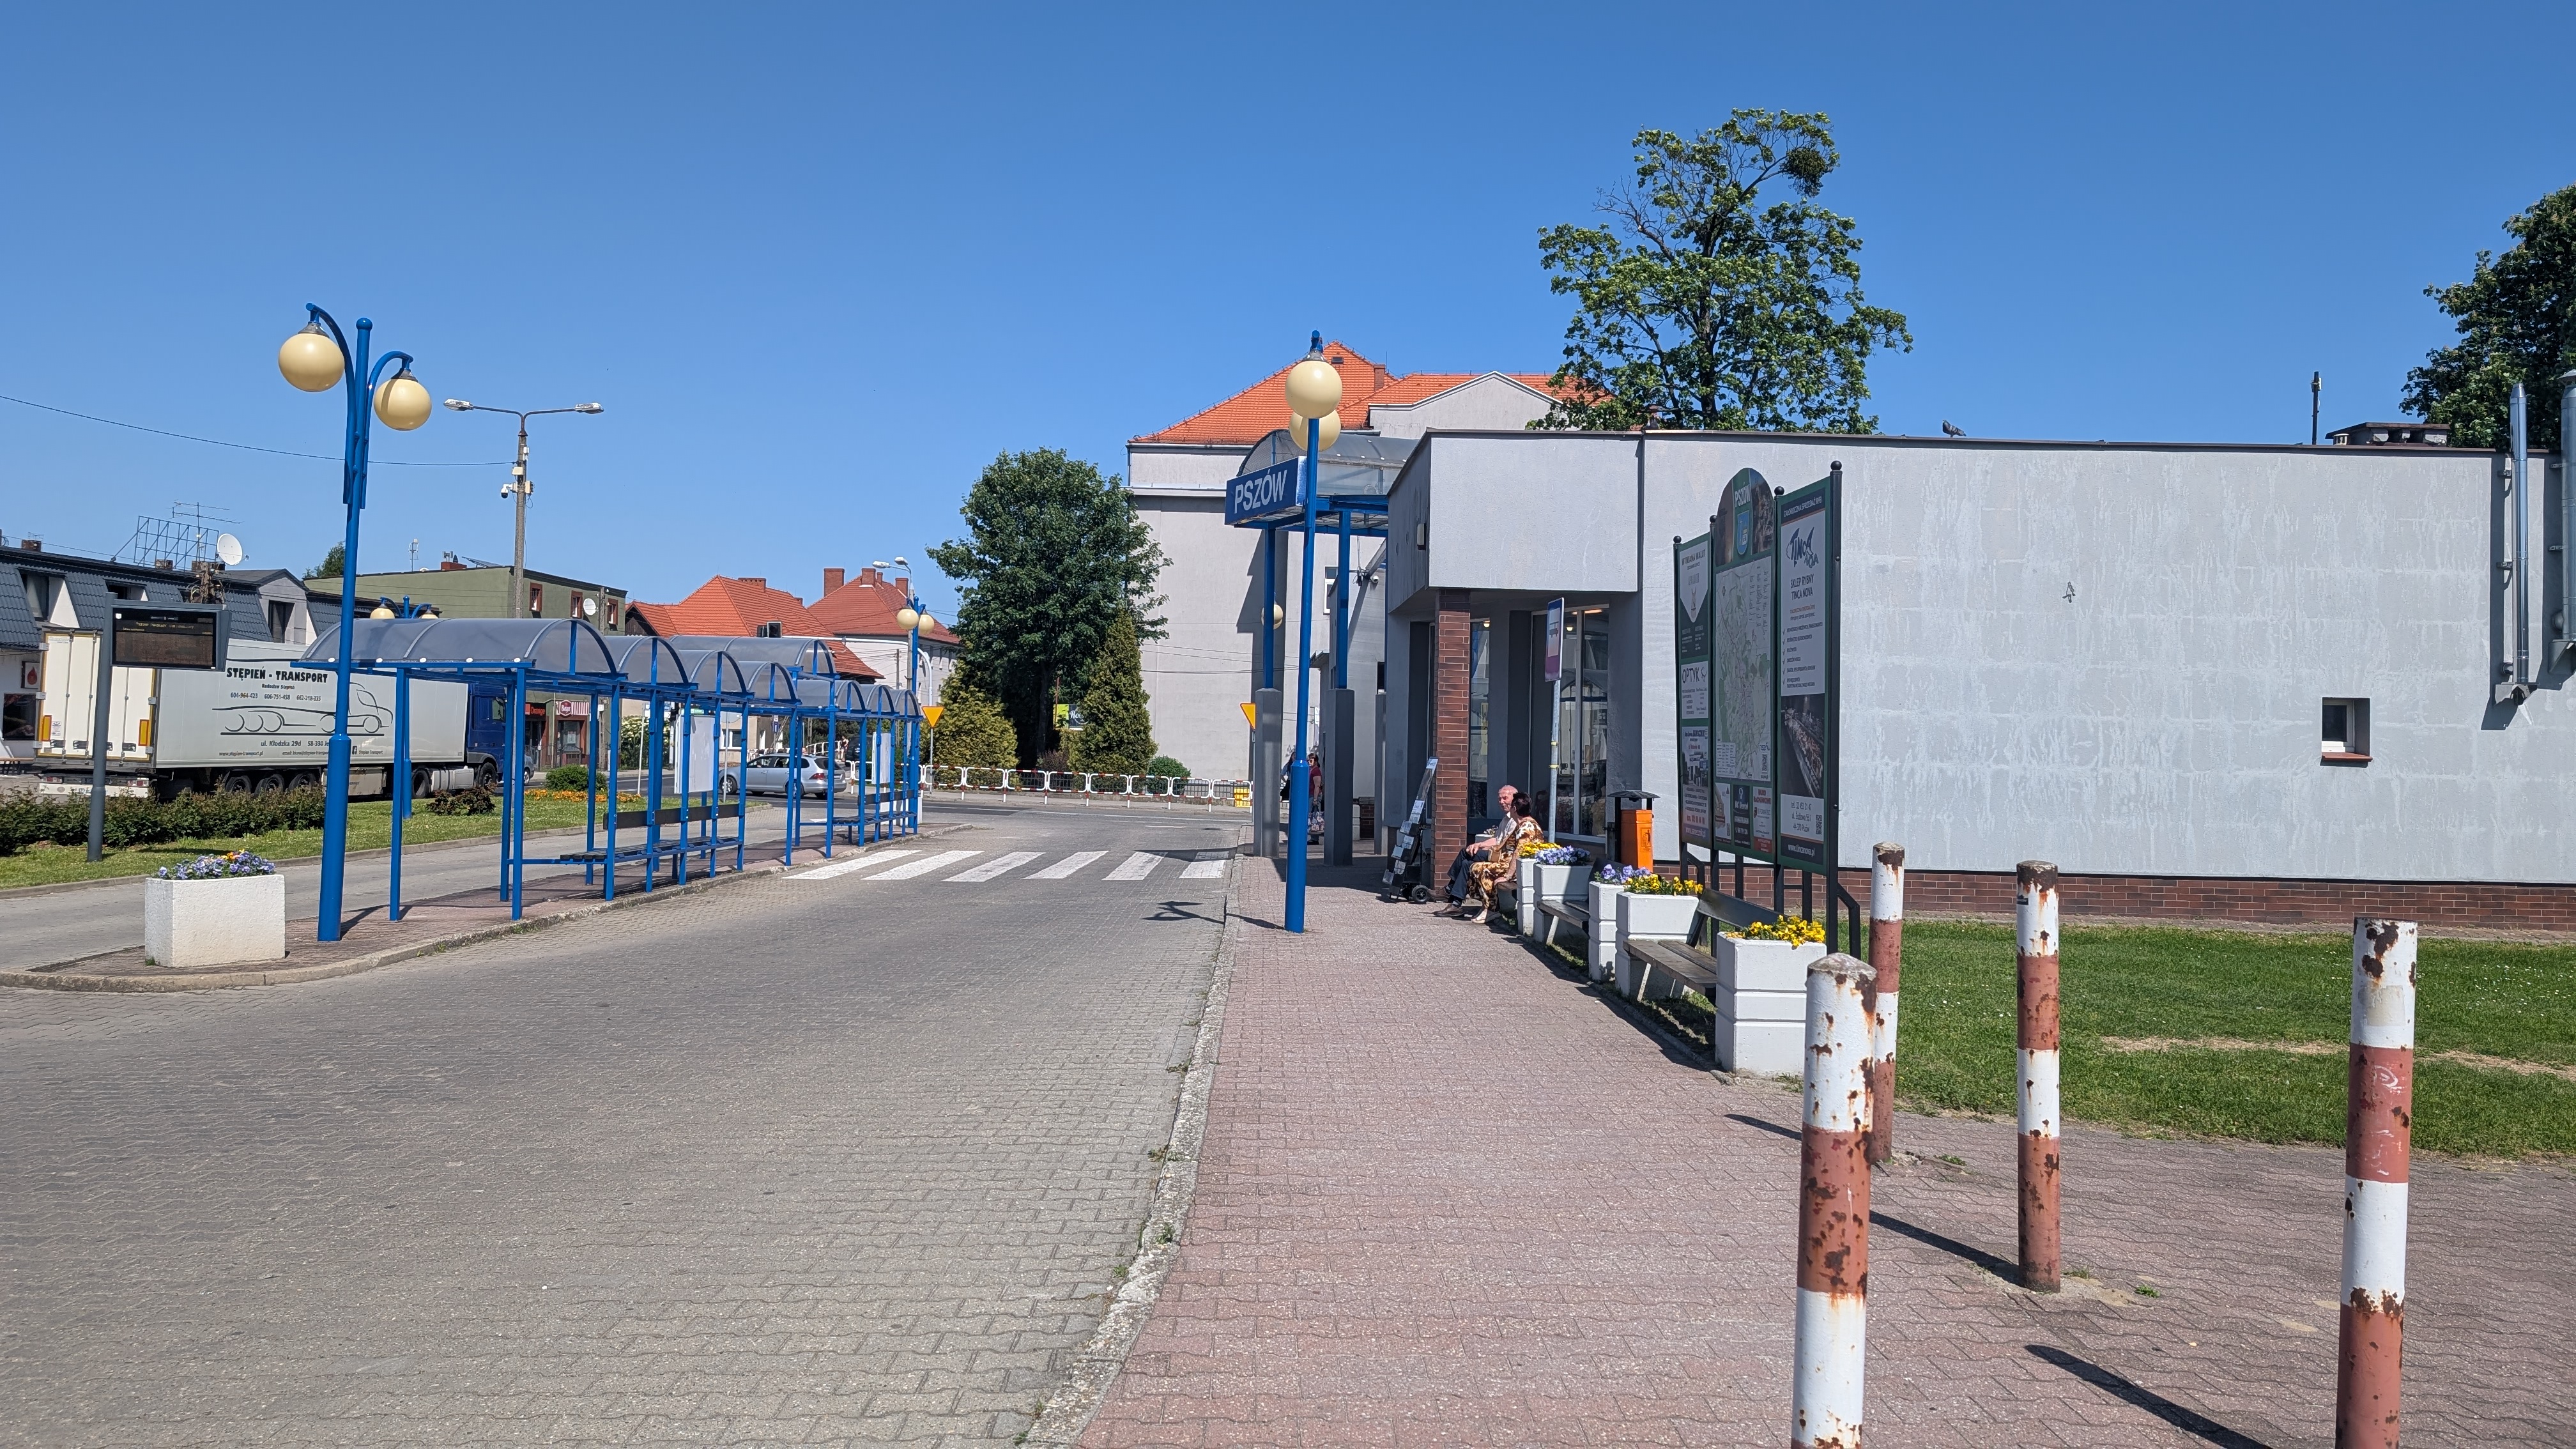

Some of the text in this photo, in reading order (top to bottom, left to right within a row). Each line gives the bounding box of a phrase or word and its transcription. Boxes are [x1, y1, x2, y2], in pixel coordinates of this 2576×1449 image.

[1234, 469, 1288, 514] PSZÓW
[1735, 482, 1751, 507] PSZÓW
[1790, 577, 1802, 589] SKLEP
[1791, 586, 1813, 601] TINCA NOVA
[227, 666, 266, 681] STĘPIEŃ
[276, 670, 328, 683] TRANSPORT
[1682, 667, 1699, 684] OPTYK
[530, 706, 546, 716] Orange
